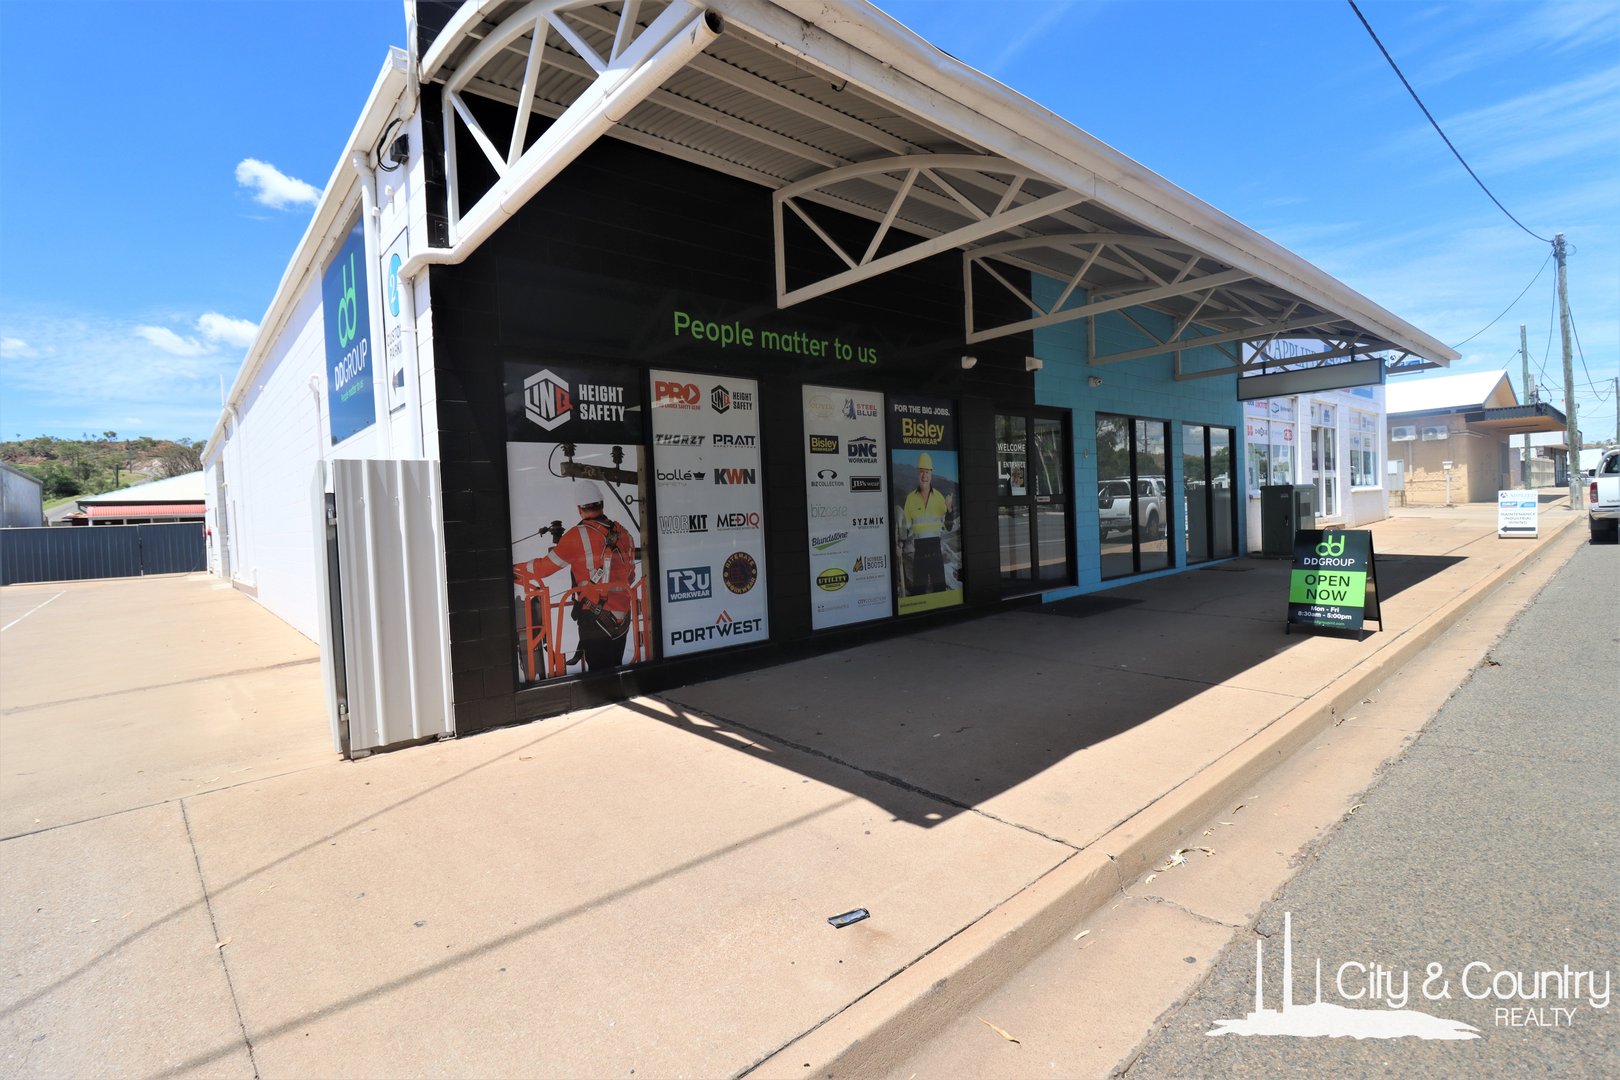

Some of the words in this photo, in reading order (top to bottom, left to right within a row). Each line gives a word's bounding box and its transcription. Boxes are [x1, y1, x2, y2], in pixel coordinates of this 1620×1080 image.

[674, 311, 754, 348] People
[761, 330, 828, 357] matter
[834, 338, 852, 361] to
[858, 347, 878, 364] us
[1274, 339, 1316, 360] APPLIE
[334, 338, 367, 391] DDGROUP
[524, 378, 574, 419] LINQ
[578, 384, 624, 403] HEIGHT
[655, 380, 701, 405] PRO
[732, 391, 752, 401] HEIGHT
[580, 403, 625, 422] SAFETY
[733, 401, 752, 411] SAFETY
[856, 403, 878, 411] STEEL
[894, 404, 908, 413] FOR
[908, 405, 921, 414] THE
[922, 406, 932, 415] BIG
[933, 407, 950, 416] JOBS.
[901, 417, 944, 443] Bisley
[713, 434, 756, 446] PRATT
[811, 437, 838, 450] Bisley
[902, 437, 938, 445] WORKWEAR
[848, 443, 878, 457] DNC
[997, 443, 1026, 452] WELCOME
[657, 469, 692, 481] bollé
[714, 468, 756, 485] KWN
[659, 515, 708, 532] WORKIT
[852, 517, 884, 527] SYZMIK
[811, 531, 848, 547] Blundstone
[1303, 557, 1355, 567] DDGROUP
[818, 575, 847, 584] UTILITY
[1304, 574, 1351, 588] OPEN
[670, 589, 710, 600] WORKWEAR
[1305, 588, 1348, 602] NOW
[1297, 610, 1322, 618] 8:30am
[1327, 612, 1352, 620] 5:00pm
[671, 618, 762, 646] PORTWEST
